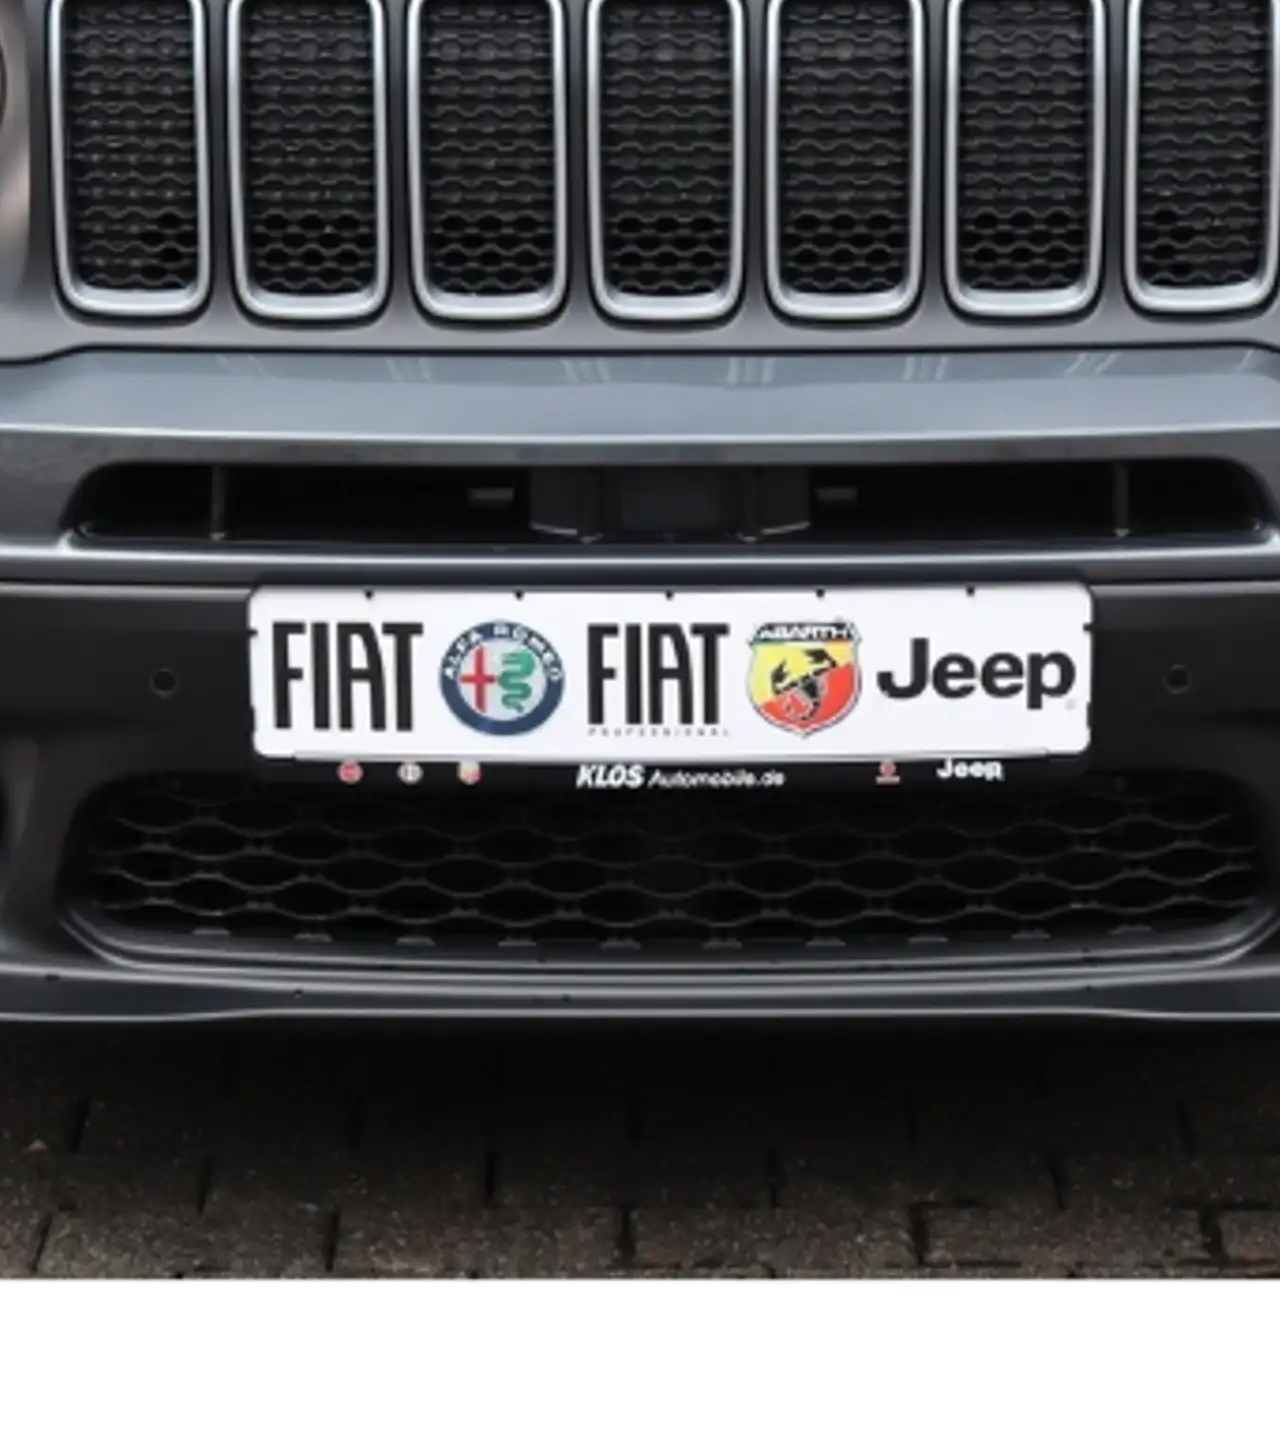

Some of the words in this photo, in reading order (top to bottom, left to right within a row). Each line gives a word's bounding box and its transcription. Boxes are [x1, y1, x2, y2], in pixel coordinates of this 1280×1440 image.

[444, 630, 484, 681] ALFA
[493, 623, 563, 682] ROMEO
[759, 624, 850, 639] ABARTH
[272, 622, 424, 731] FIAT
[587, 623, 730, 725] FIAT
[876, 637, 1076, 710] Jeep
[576, 764, 644, 788] KLOS
[647, 768, 786, 788] Automobile.de
[936, 757, 1004, 781] Jeep
